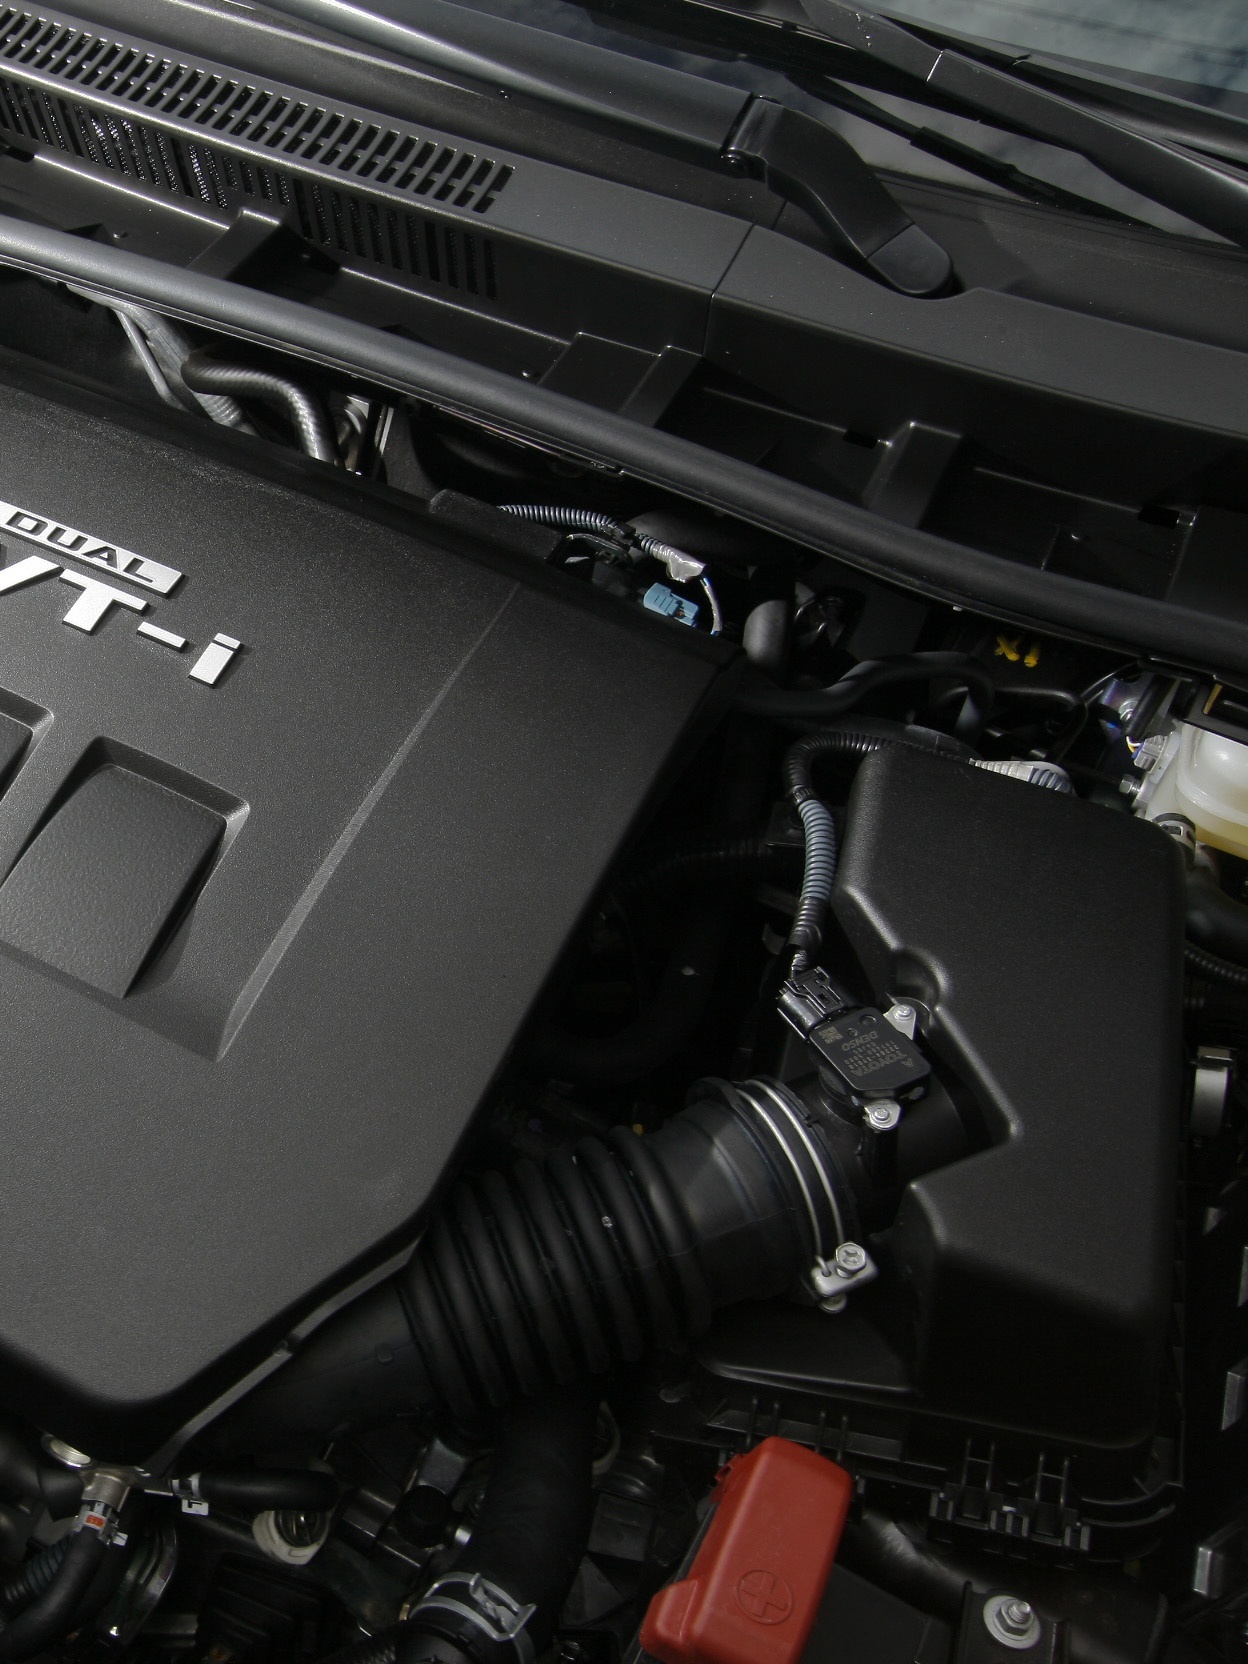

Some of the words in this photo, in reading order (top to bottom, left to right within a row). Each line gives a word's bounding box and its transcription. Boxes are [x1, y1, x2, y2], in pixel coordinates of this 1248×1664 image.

[5, 510, 155, 584] DUAL
[841, 1030, 878, 1052] DENSO
[850, 1050, 907, 1077] TOYOTA
